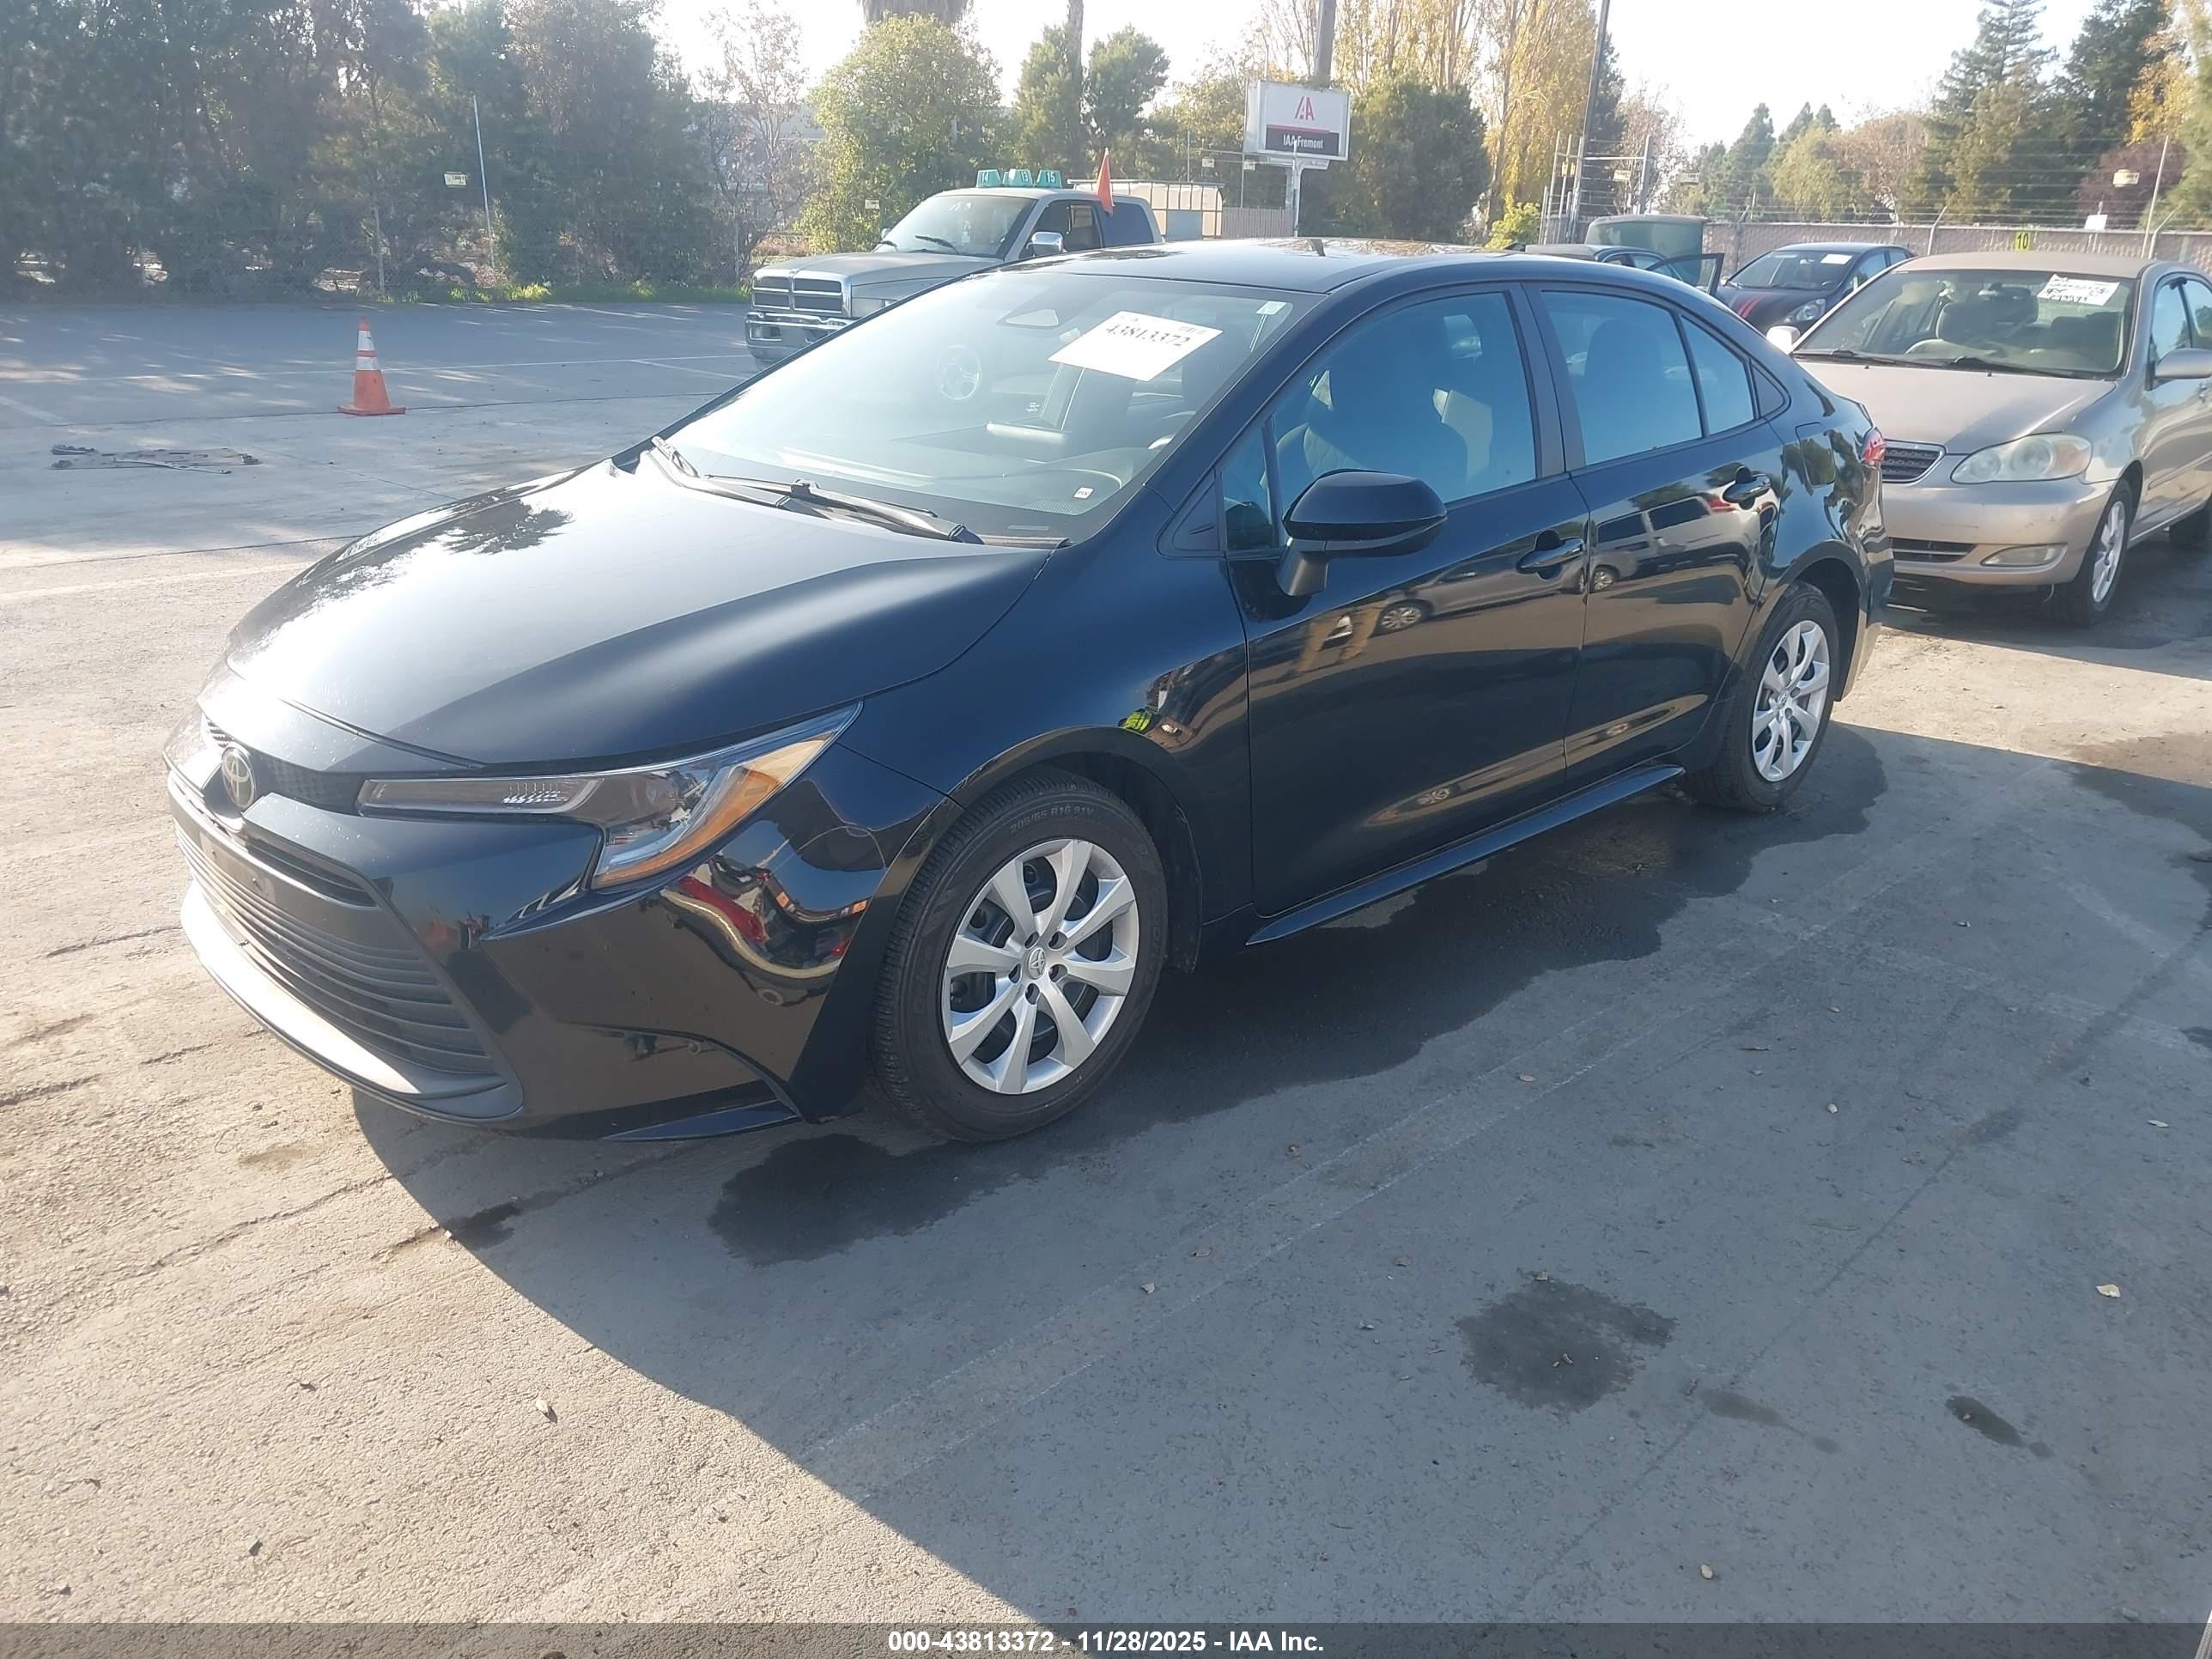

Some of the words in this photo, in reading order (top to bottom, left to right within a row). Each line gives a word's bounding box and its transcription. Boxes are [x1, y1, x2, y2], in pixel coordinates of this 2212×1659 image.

[1297, 135, 1323, 149] Fremont
[981, 172, 989, 183] 14
[1021, 171, 1029, 183] 13
[1047, 171, 1055, 183] 15
[2017, 233, 2029, 250] 10
[1105, 324, 1191, 346] 43813372
